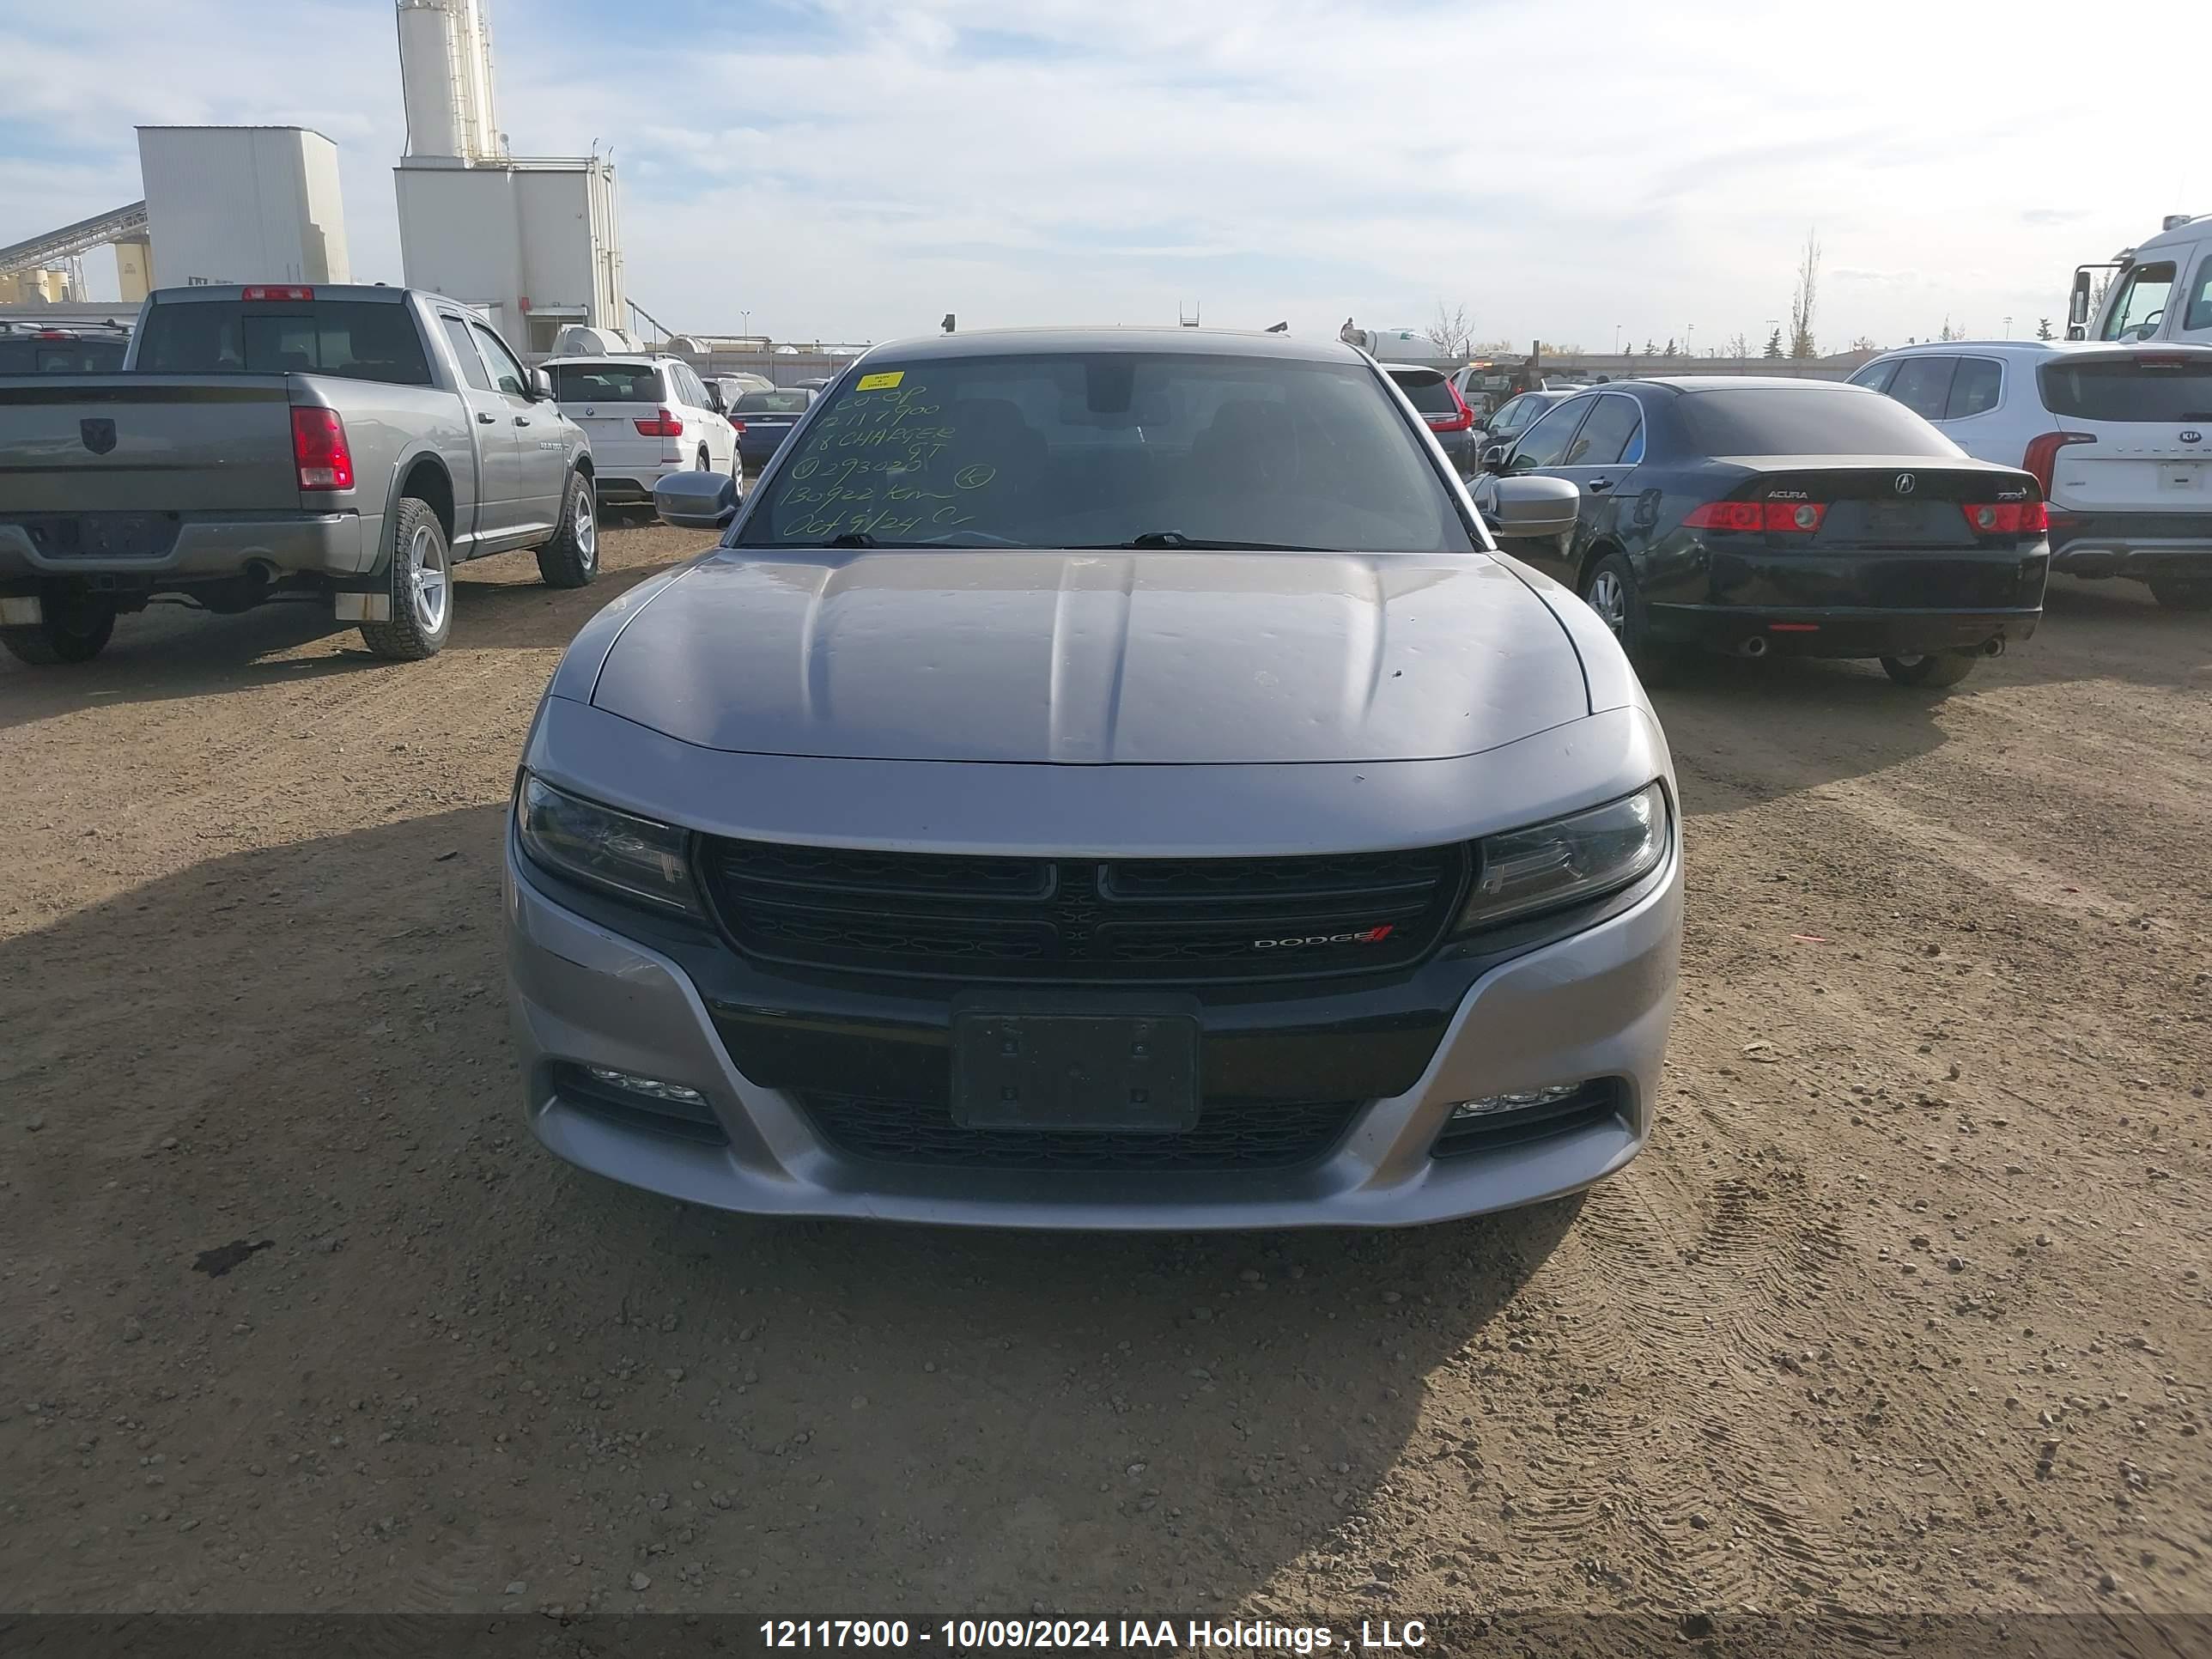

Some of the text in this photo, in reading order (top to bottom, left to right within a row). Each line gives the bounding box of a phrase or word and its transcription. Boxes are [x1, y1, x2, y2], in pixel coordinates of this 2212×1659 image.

[838, 428, 956, 447] CHARGER
[2182, 432, 2199, 441] KIA
[780, 487, 873, 514] 130922
[1767, 490, 1808, 499] ACURA
[1254, 931, 1374, 949] DODGE
